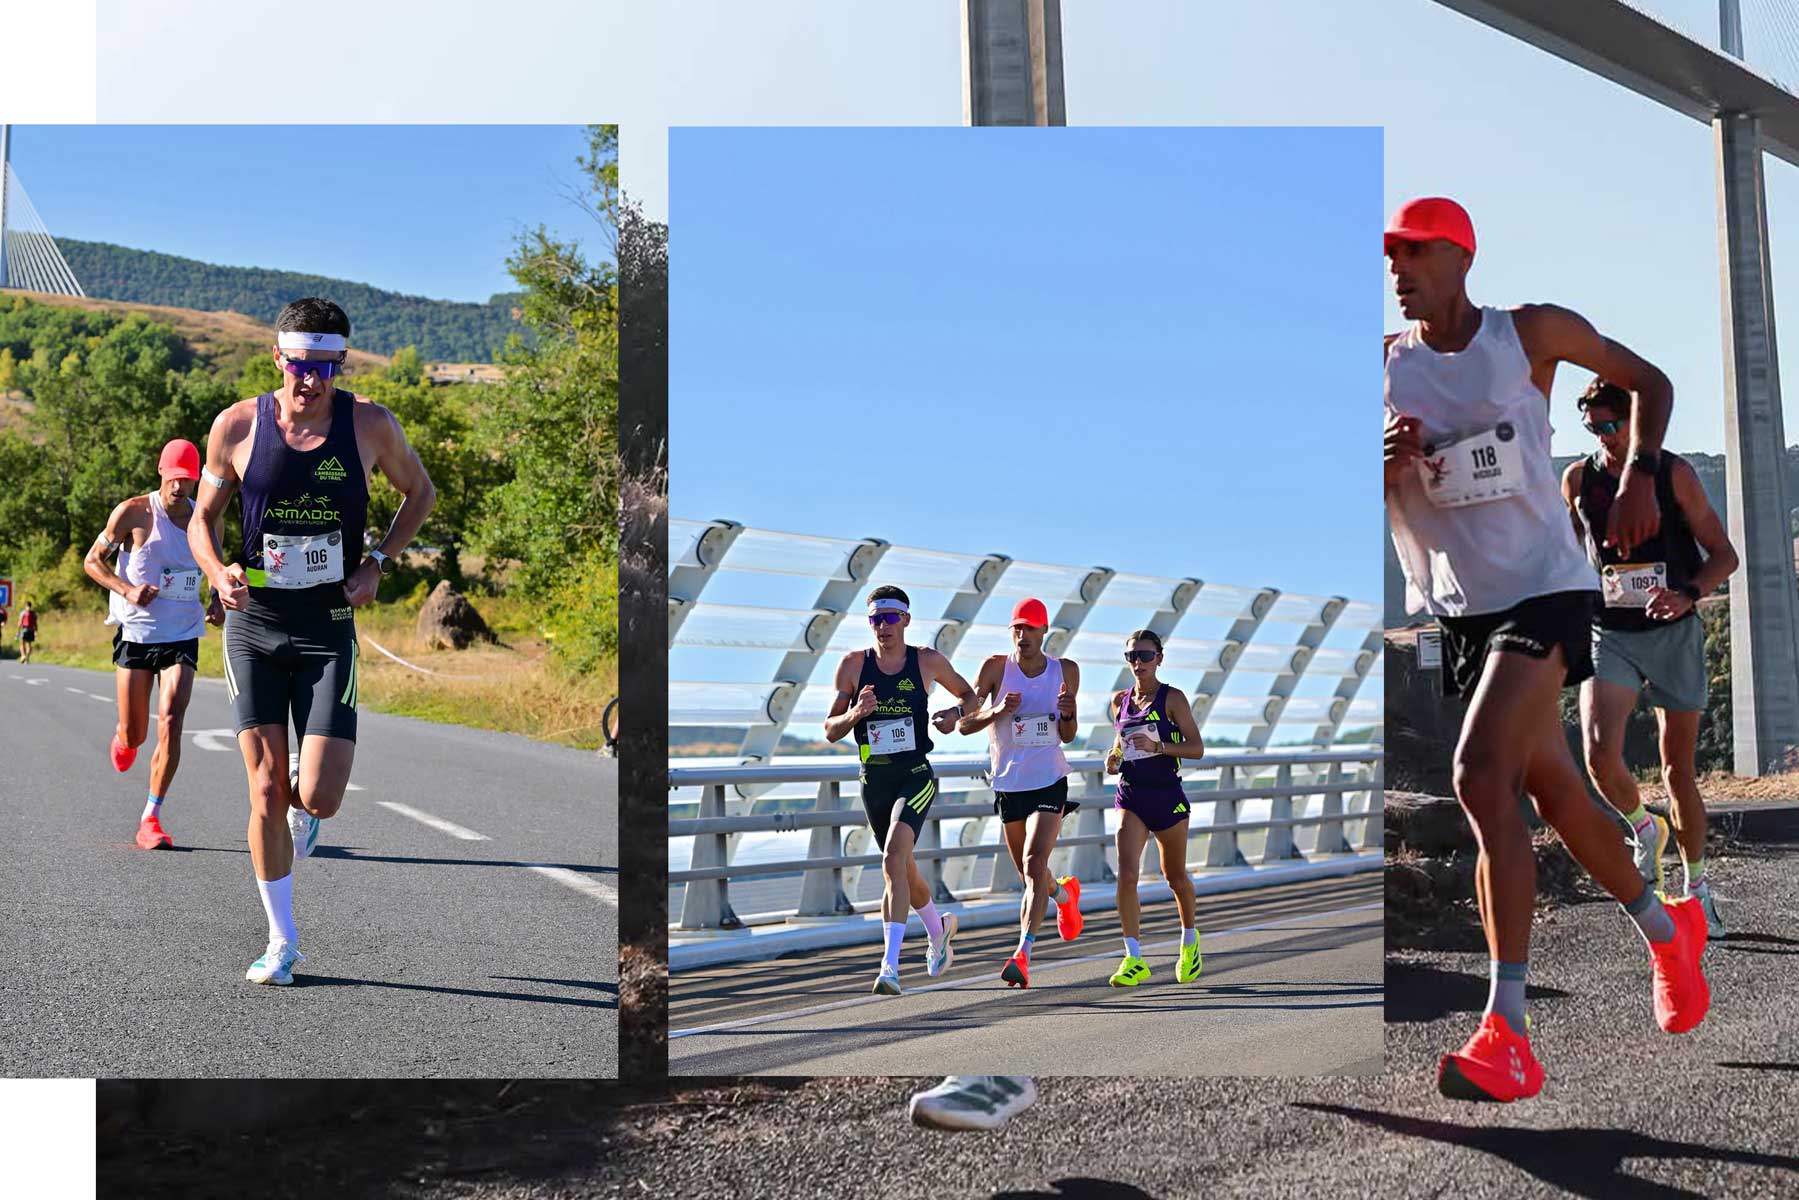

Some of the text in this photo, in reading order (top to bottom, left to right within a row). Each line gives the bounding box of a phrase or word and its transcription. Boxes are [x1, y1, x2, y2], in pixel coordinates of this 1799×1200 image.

[1471, 445, 1497, 469] 118
[264, 508, 340, 521] ARMADOC
[305, 549, 328, 565] 106
[306, 564, 328, 573] AUDRAN
[1037, 722, 1048, 732] 118
[892, 728, 905, 738] 106
